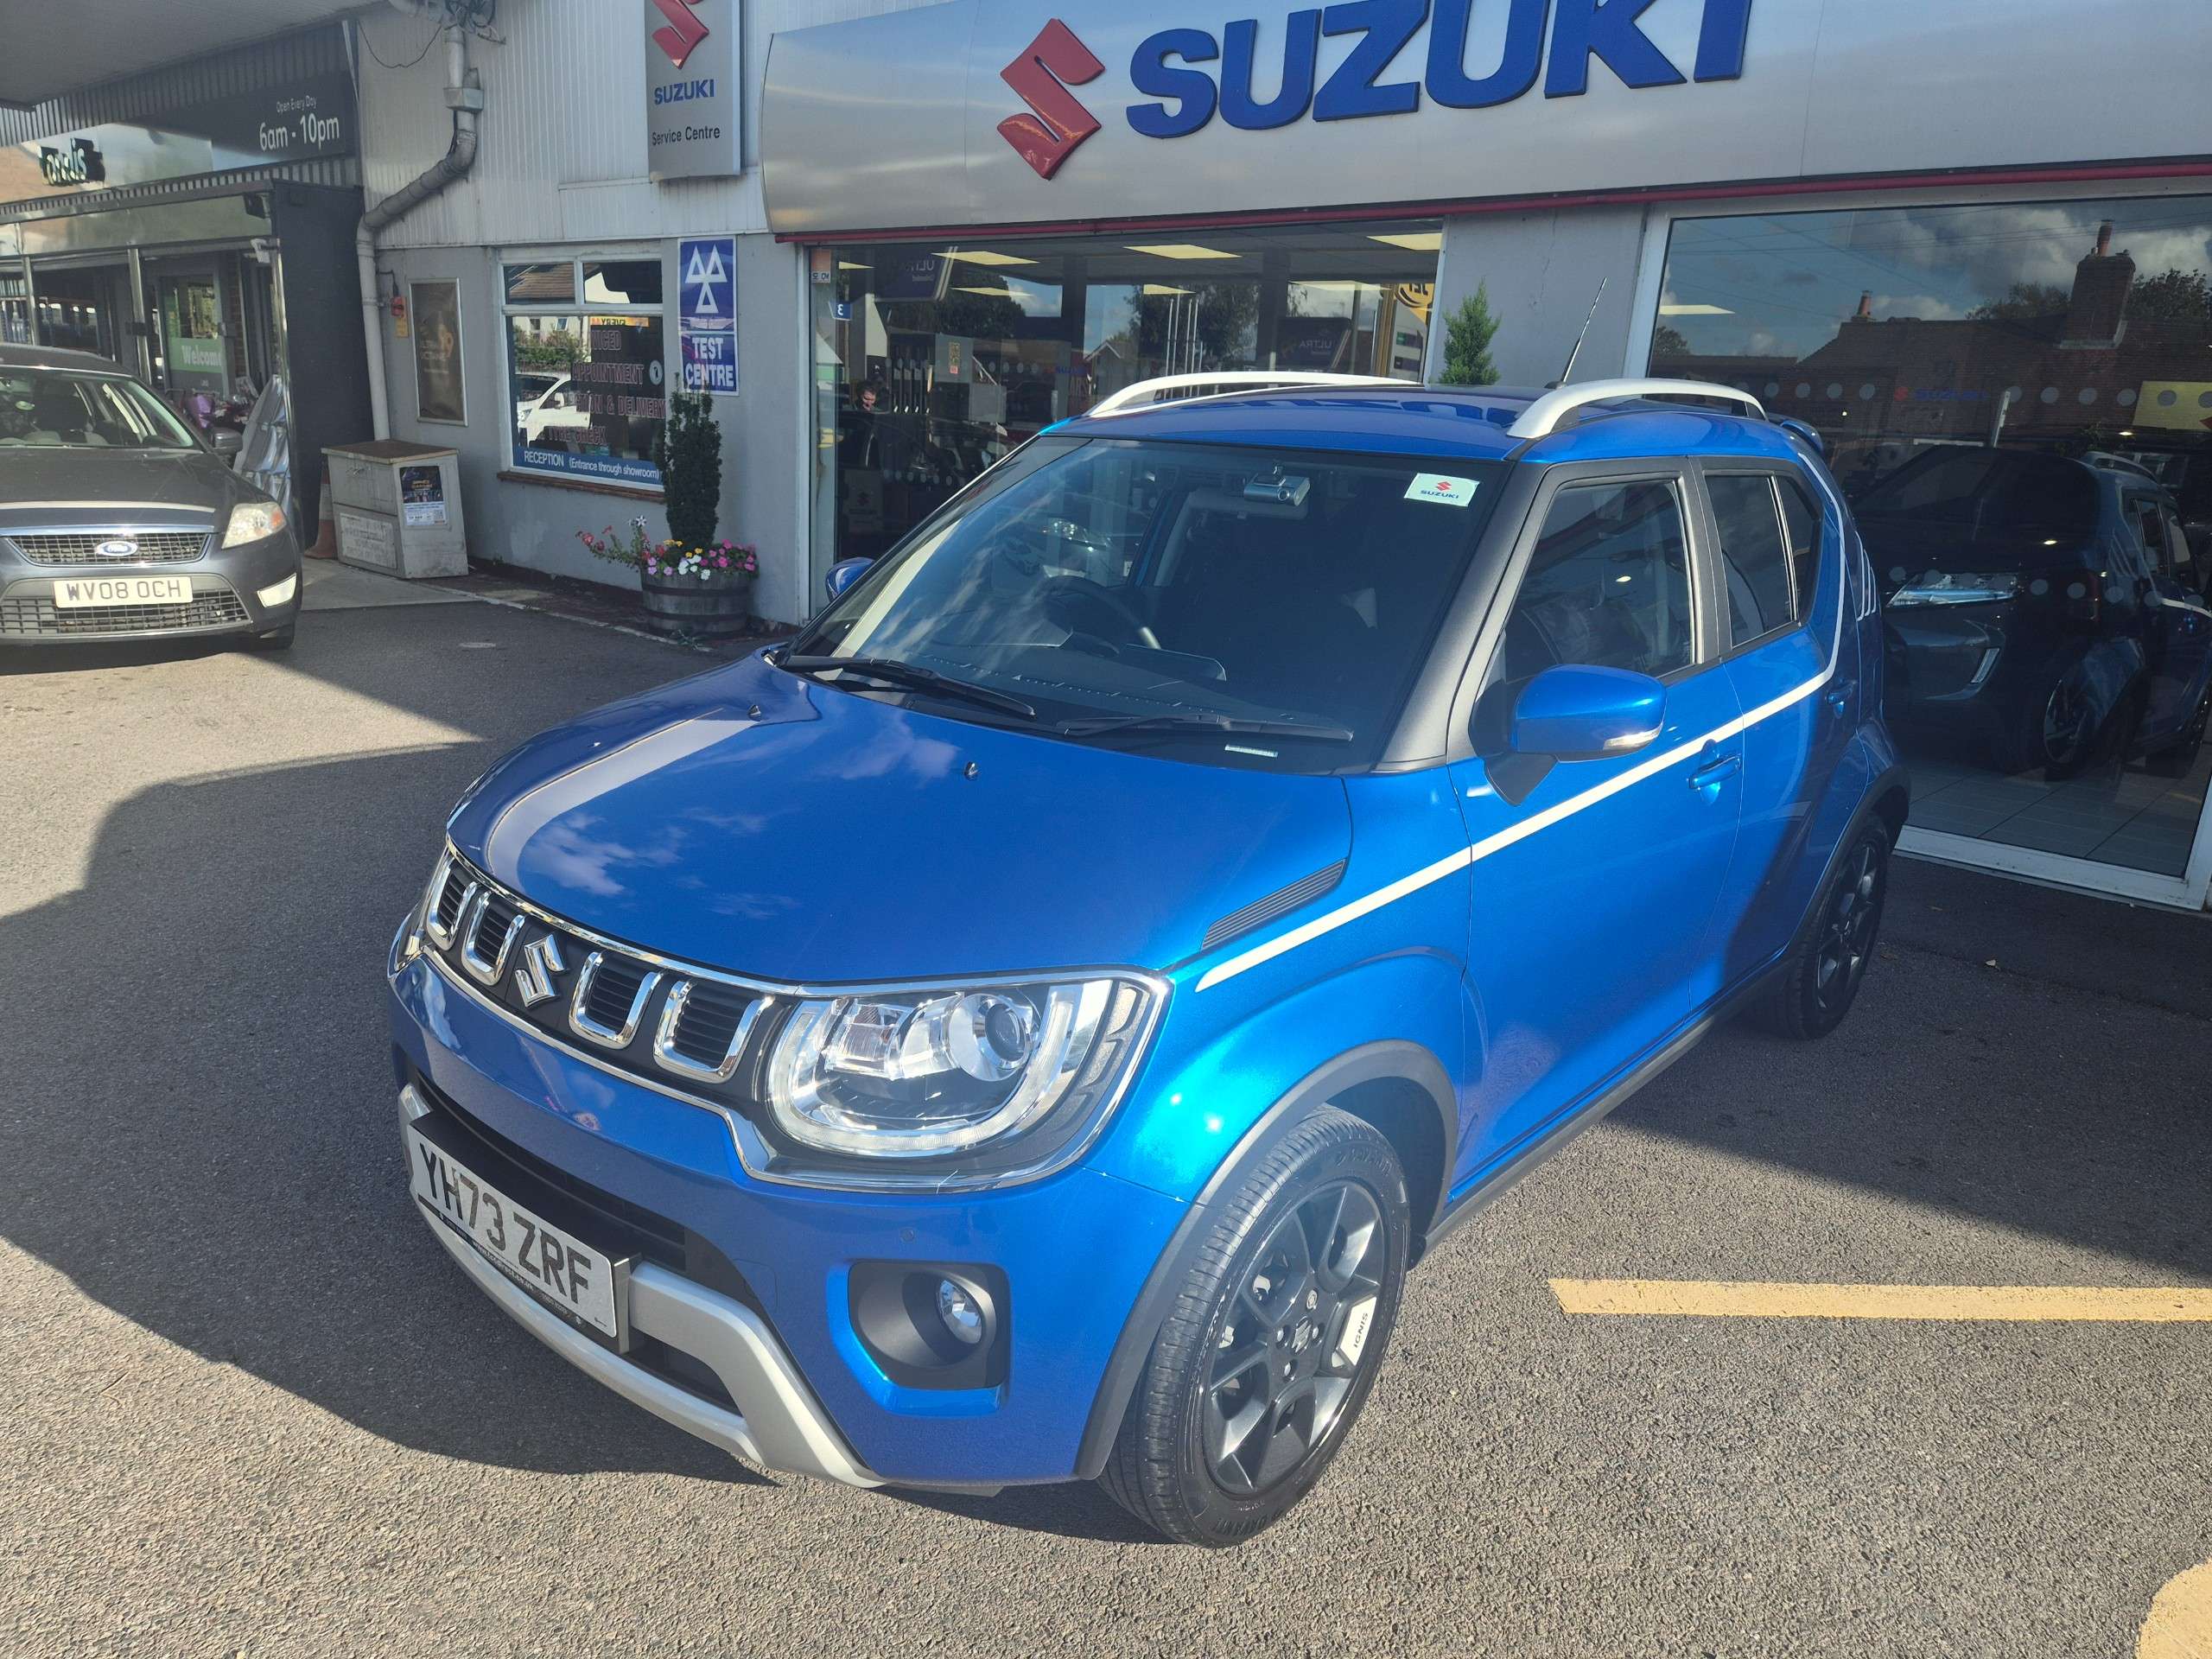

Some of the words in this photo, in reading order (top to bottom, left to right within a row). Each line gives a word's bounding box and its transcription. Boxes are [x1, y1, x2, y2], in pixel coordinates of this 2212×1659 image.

[1126, 0, 1752, 139] SUZUKI
[653, 79, 715, 105] SUZUKI
[259, 122, 289, 151] 6am
[299, 112, 340, 150] 10pm
[652, 130, 682, 146] Service
[685, 125, 721, 140] Centre
[691, 337, 723, 359] TEST
[685, 363, 734, 387] CENTRE
[617, 395, 666, 420] DELIVERY
[524, 450, 565, 467] RECEPTION
[569, 457, 598, 472] (Entrance
[598, 461, 622, 476] through
[622, 466, 659, 480] showroom)
[1420, 489, 1459, 499] SUZUKI
[66, 582, 130, 601] WV08
[137, 580, 181, 599] OCH
[419, 1142, 506, 1252] YH73
[513, 1211, 592, 1305] ZRF
[1353, 1313, 1369, 1349] IGNIS
